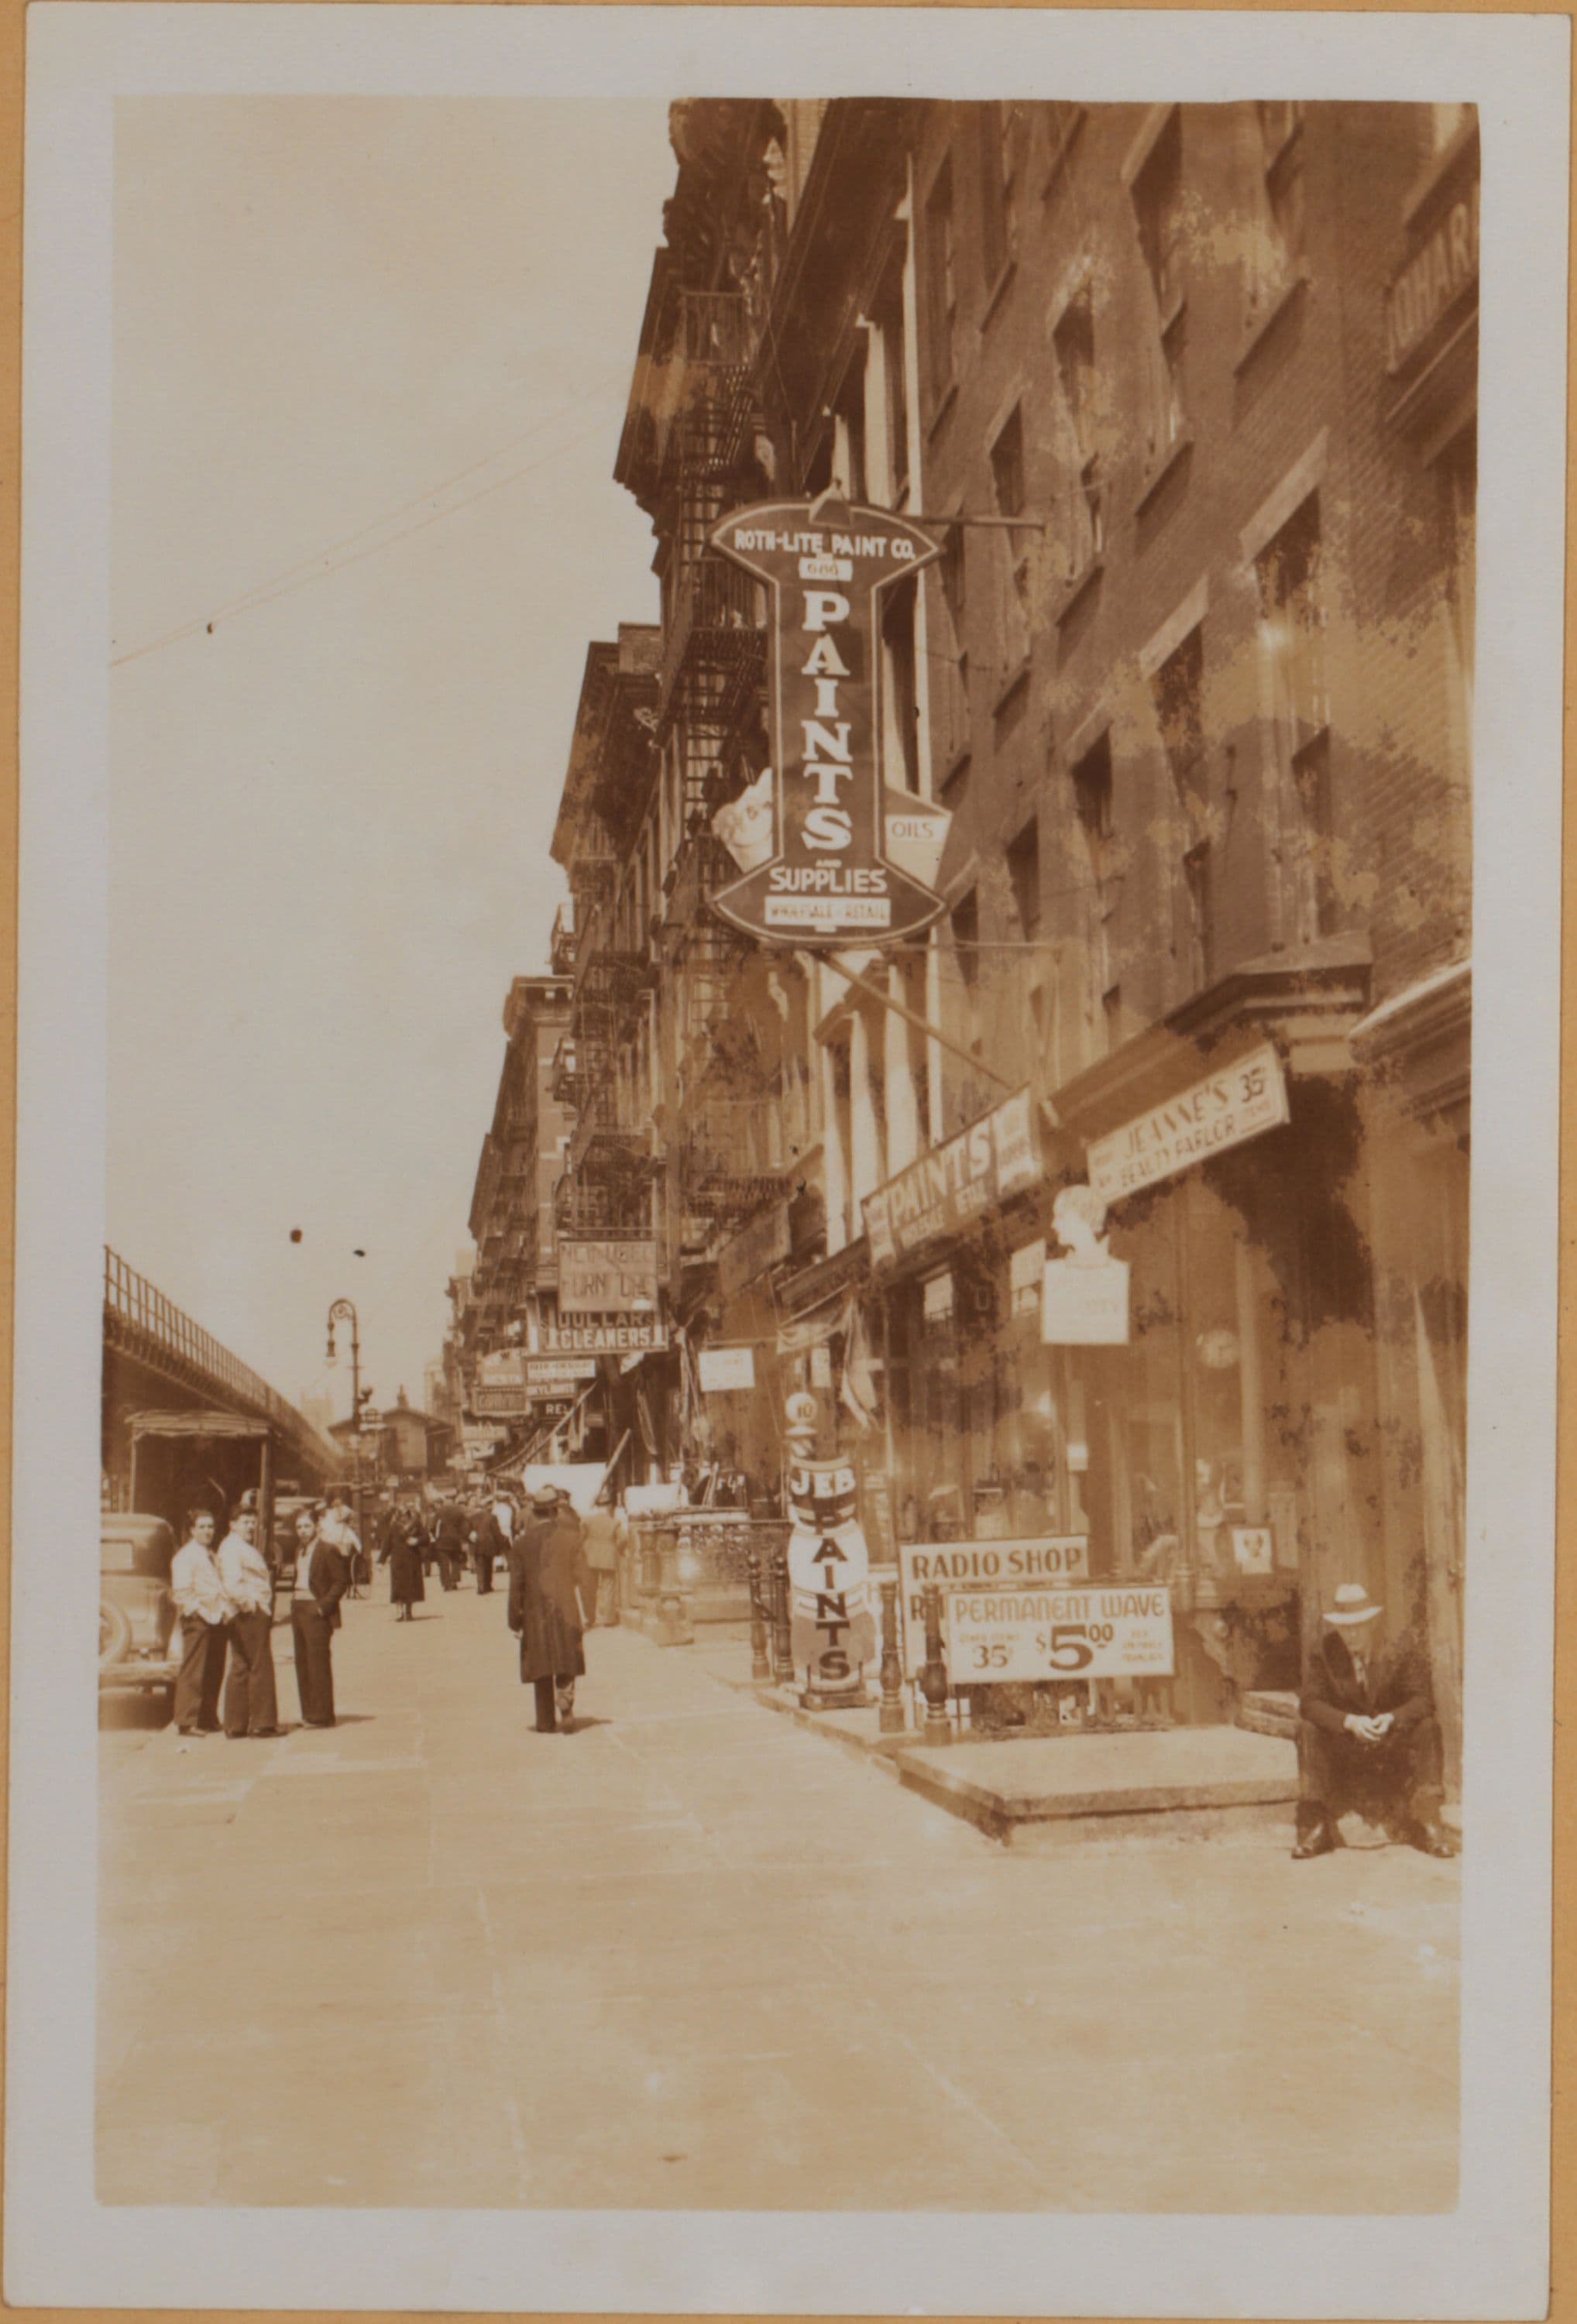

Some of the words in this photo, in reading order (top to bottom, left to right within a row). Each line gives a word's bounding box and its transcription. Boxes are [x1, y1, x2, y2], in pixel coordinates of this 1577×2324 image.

[735, 529, 823, 554] ROTH-LITE
[831, 533, 887, 558] PAINT
[801, 590, 854, 850] PAINTS
[891, 821, 934, 839] OILS
[769, 867, 887, 893] SUPPLIES
[890, 1115, 993, 1231] PAINTS
[560, 1327, 651, 1351] CLEANERS
[912, 1551, 1000, 1580] RADIO
[1008, 1547, 1081, 1575] SHOP
[813, 1501, 852, 1682] PAINTS
[955, 1595, 1091, 1623] PERMANENT
[1101, 1593, 1165, 1619] WAVE
